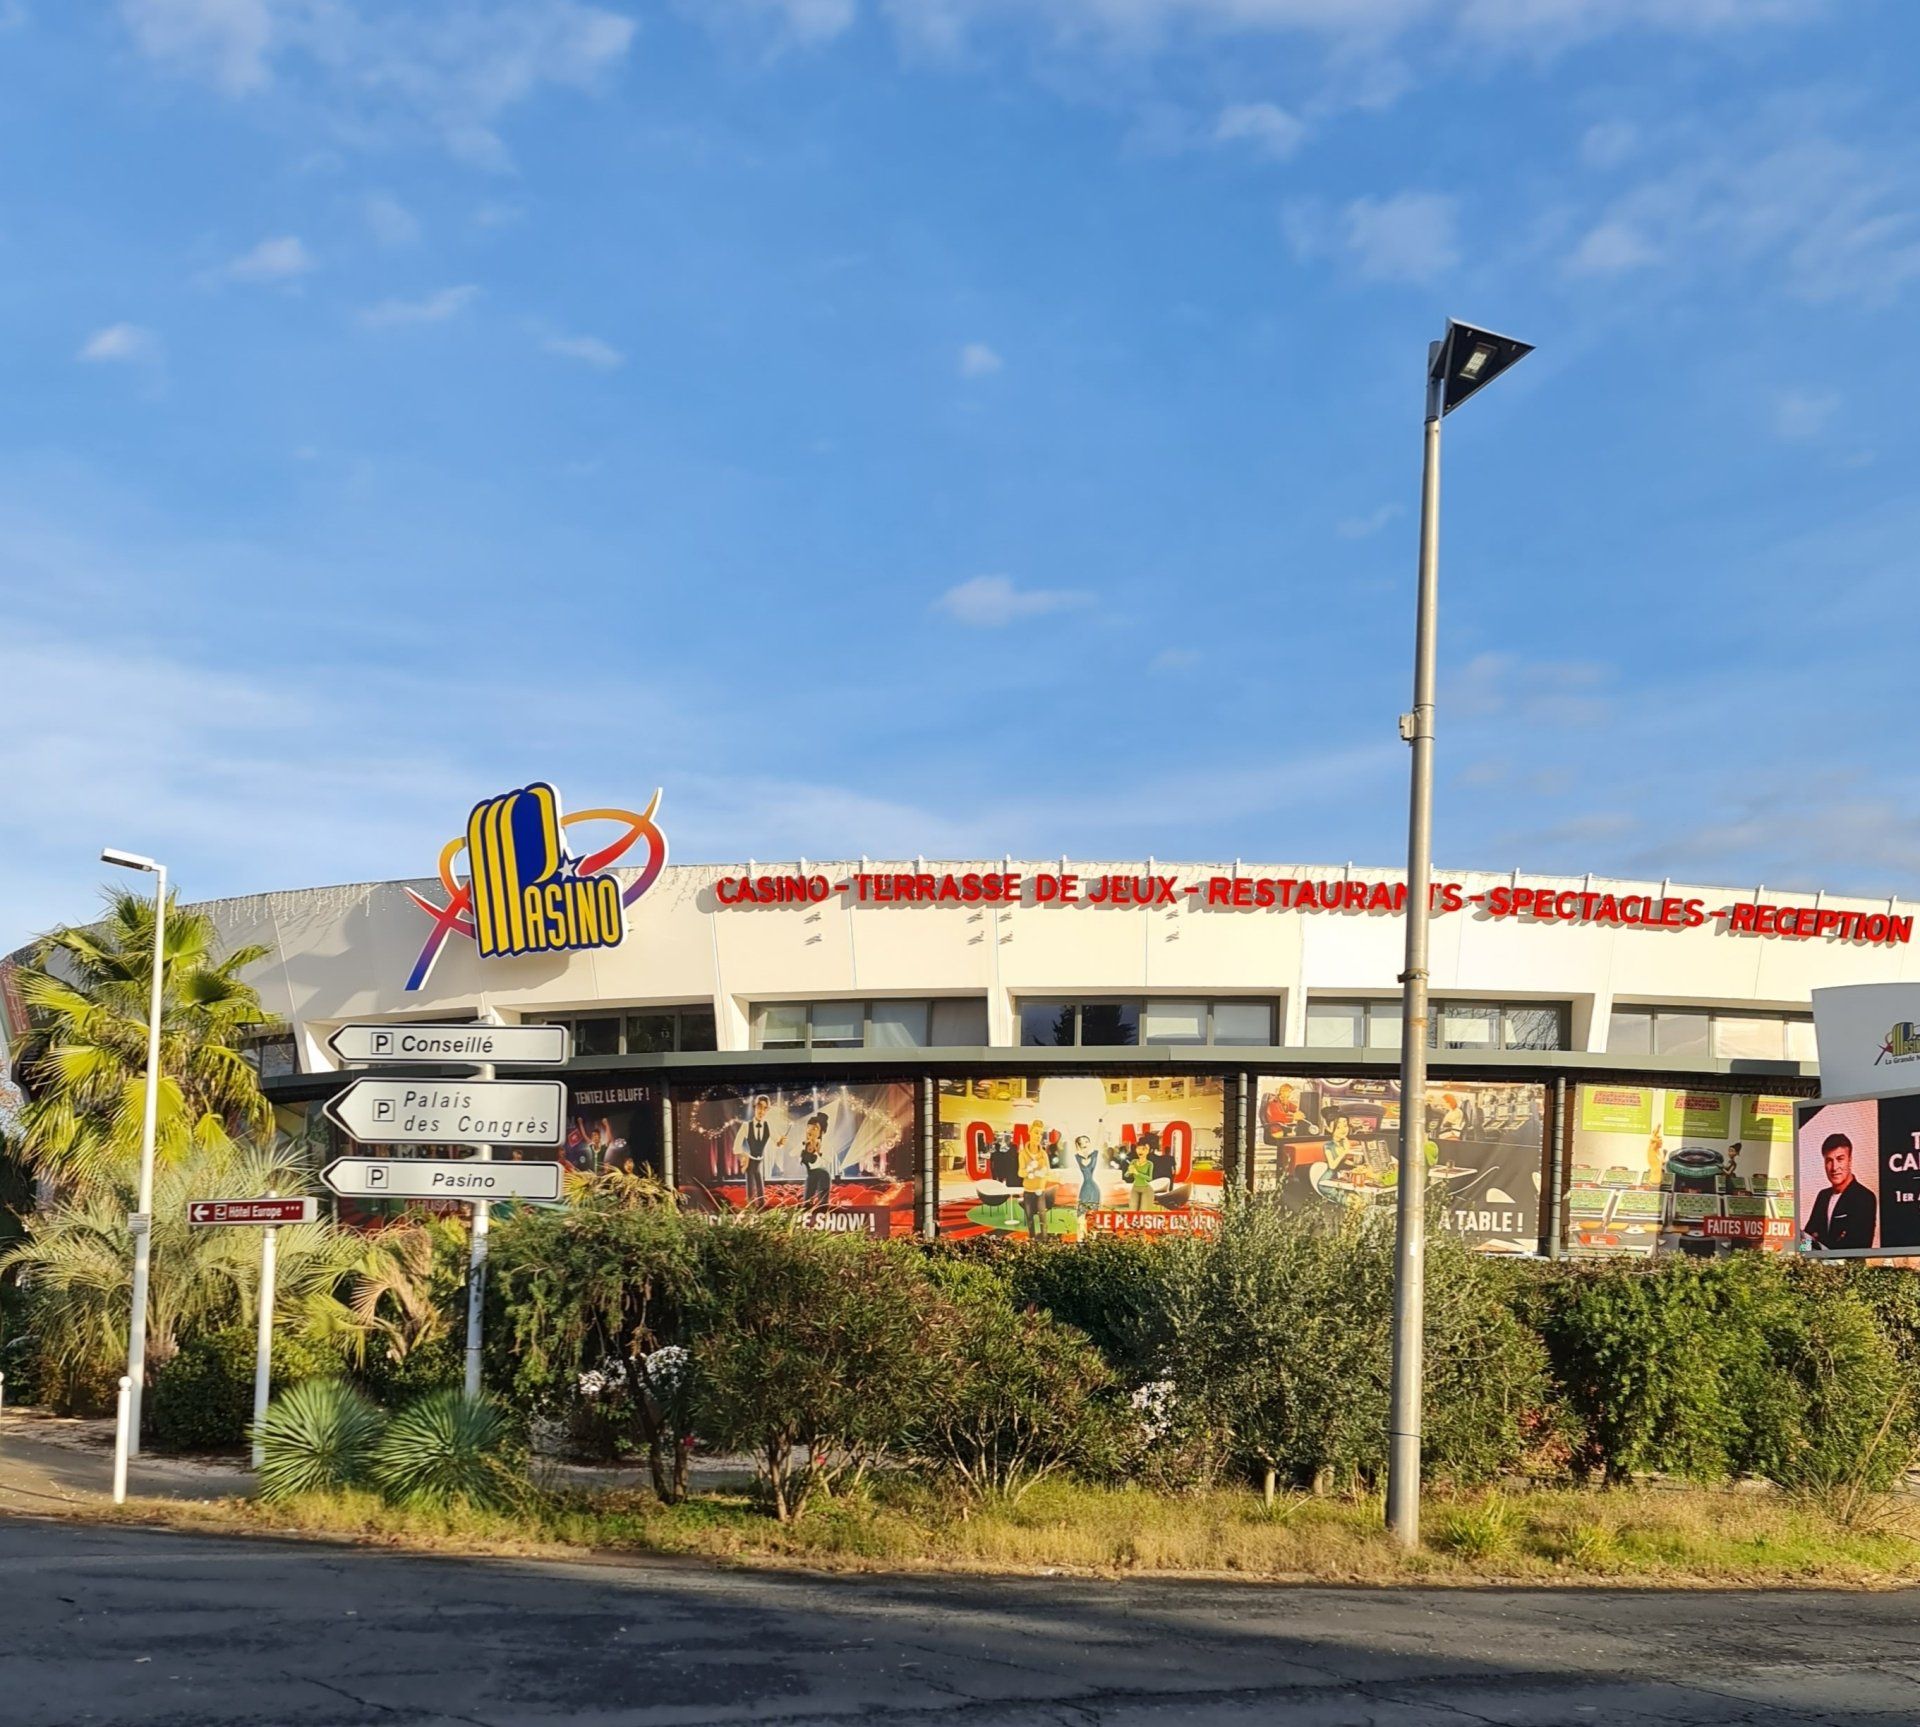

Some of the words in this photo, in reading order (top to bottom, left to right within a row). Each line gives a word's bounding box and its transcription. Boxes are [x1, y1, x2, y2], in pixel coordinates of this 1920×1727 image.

[716, 875, 829, 904] CASINO
[853, 873, 1022, 902] TERRASSE
[1036, 874, 1079, 903] DE
[1089, 875, 1177, 905] JEUX
[1487, 886, 1706, 927] SPECTACLES
[1729, 903, 1914, 943] RECEPTION
[375, 1035, 389, 1052] P
[401, 1035, 493, 1053] Conseillé
[403, 1091, 472, 1108] Palais
[575, 1090, 604, 1104] TENTEZ
[605, 1089, 616, 1103] LE
[618, 1088, 644, 1102] BLUFF
[377, 1102, 390, 1118] P
[404, 1115, 440, 1132] des
[458, 1116, 549, 1138] Congrès
[370, 1168, 384, 1186] P
[432, 1173, 496, 1188] Pasino
[228, 1205, 250, 1217] Hôtel
[252, 1205, 282, 1219] Europe
[814, 1211, 865, 1232] SHOW
[1096, 1213, 1111, 1229] LE
[1115, 1213, 1166, 1230] PLAISIR
[1455, 1210, 1513, 1233] TABLE
[1707, 1219, 1741, 1235] FAITES
[1743, 1220, 1764, 1236] VOS
[1765, 1222, 1791, 1237] JEUX
